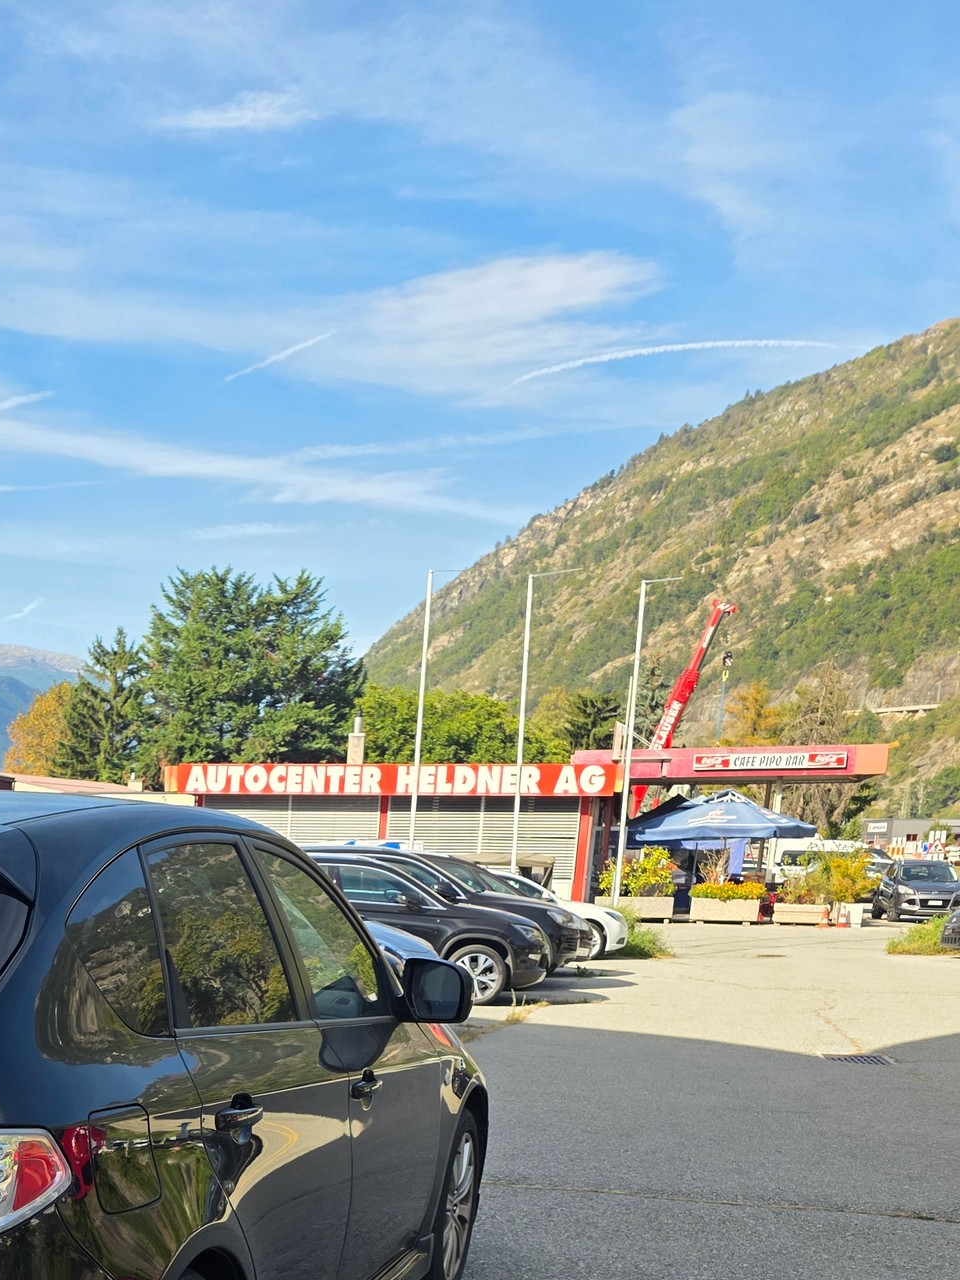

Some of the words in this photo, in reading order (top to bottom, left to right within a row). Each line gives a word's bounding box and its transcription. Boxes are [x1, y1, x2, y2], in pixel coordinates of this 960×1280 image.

[734, 756, 756, 767] CAFE
[759, 755, 782, 767] PIPO
[785, 755, 805, 766] BAR
[185, 765, 381, 793] AUTOCENTER
[396, 765, 541, 793] HELDNER
[553, 765, 606, 793] AG
